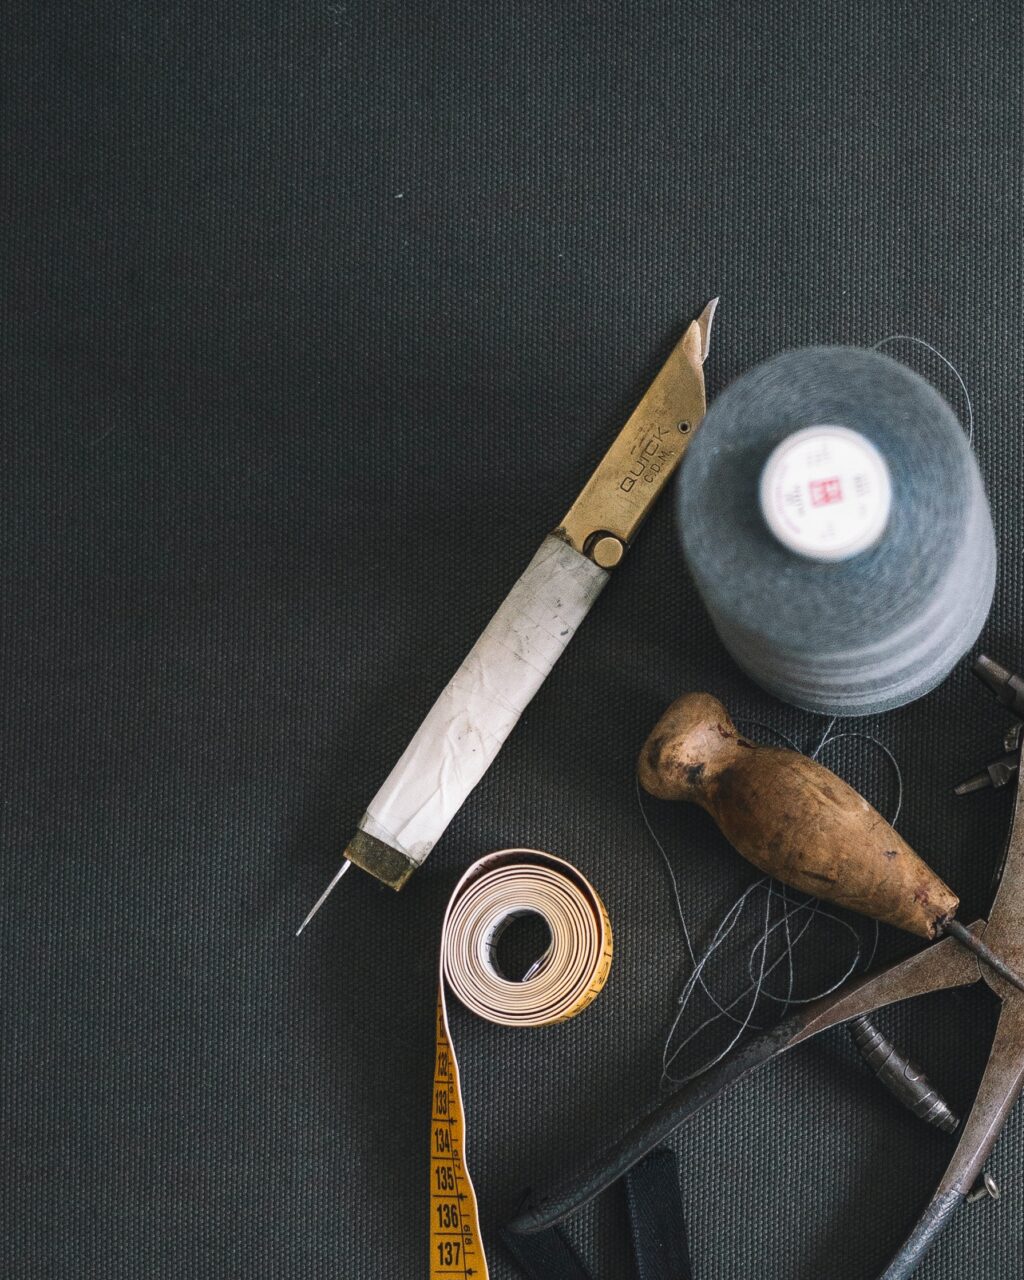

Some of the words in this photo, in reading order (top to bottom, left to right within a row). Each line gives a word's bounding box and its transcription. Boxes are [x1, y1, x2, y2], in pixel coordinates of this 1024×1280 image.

[620, 426, 670, 493] QUICK
[435, 1090, 448, 1115] 133
[434, 1127, 450, 1153] 134
[435, 1166, 455, 1191] 135
[437, 1204, 459, 1229] 136
[463, 1224, 473, 1246] 68
[437, 1242, 461, 1266] 137
